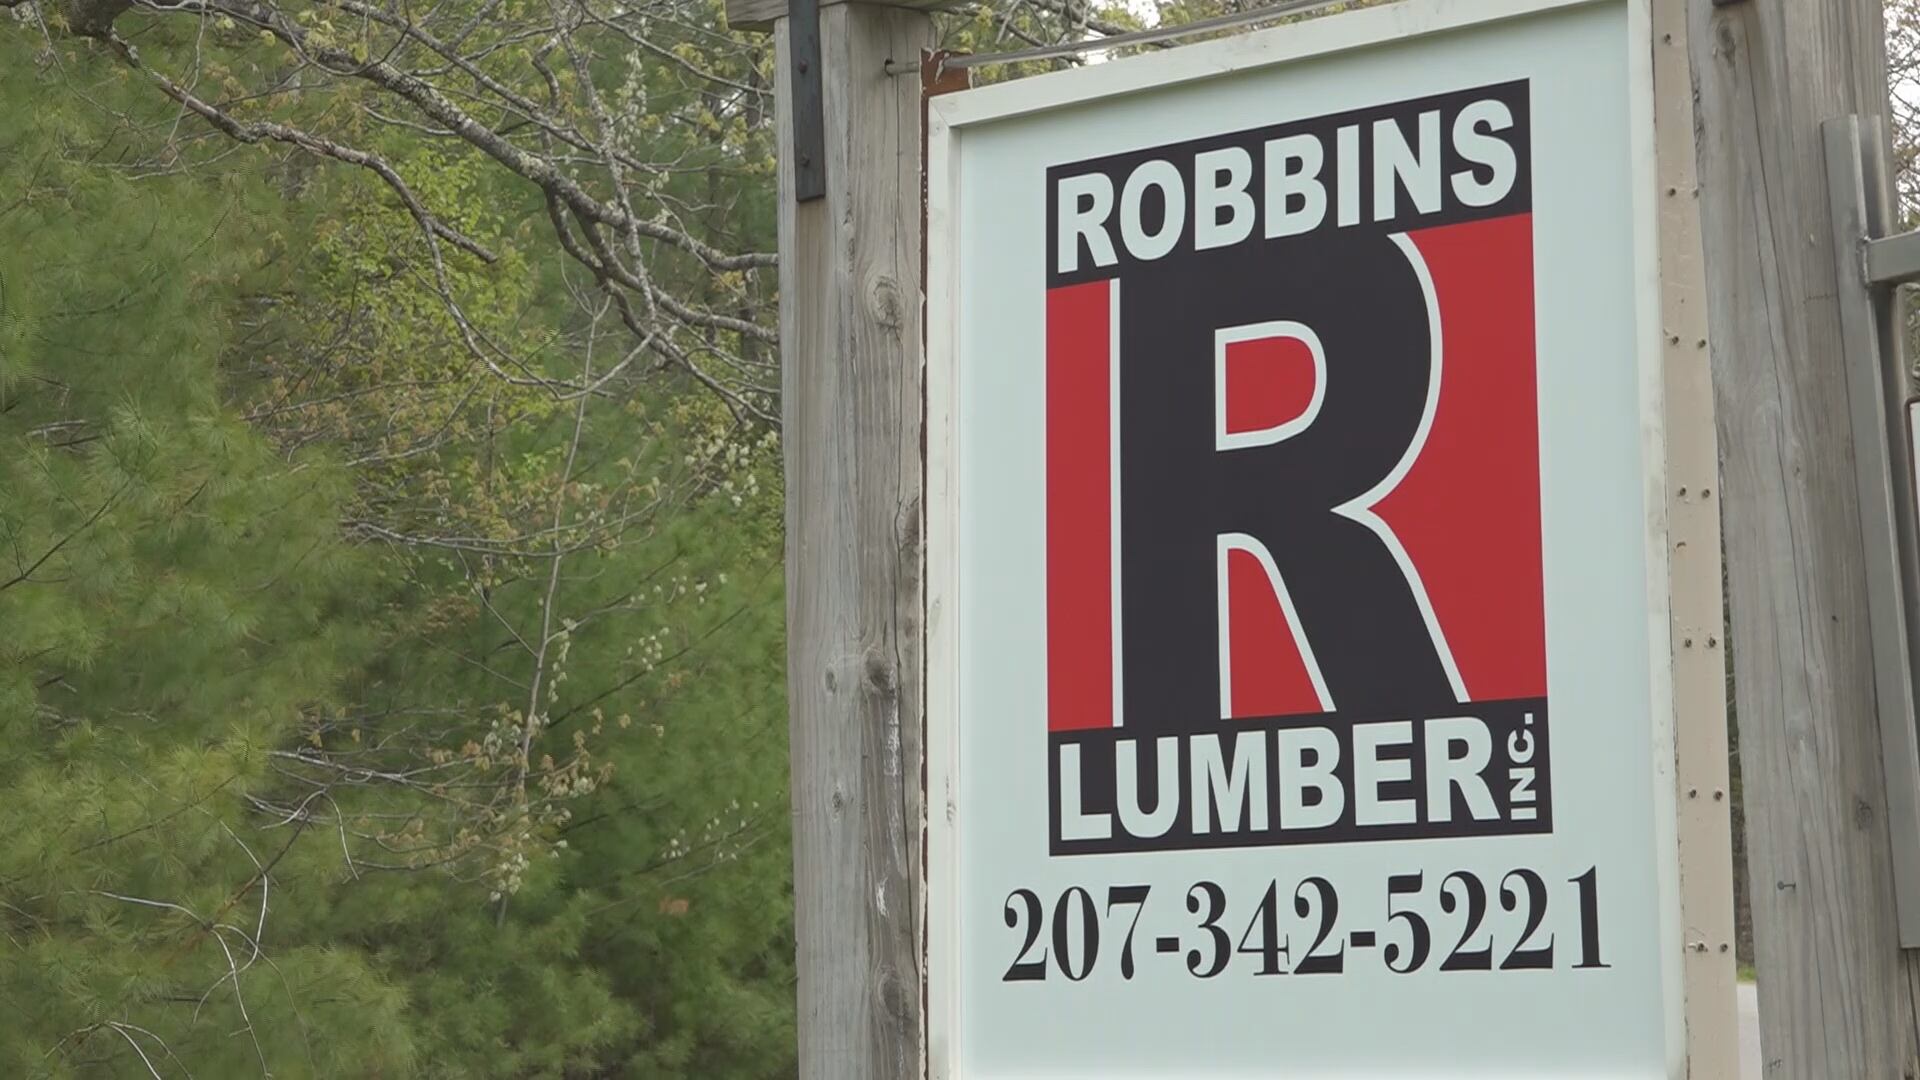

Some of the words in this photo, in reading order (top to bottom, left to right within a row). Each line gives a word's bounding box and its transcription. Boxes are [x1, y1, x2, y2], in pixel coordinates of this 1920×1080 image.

[1058, 100, 1516, 273] ROBBINS
[1110, 232, 1471, 728] R
[1060, 717, 1500, 840] LUMBER
[1508, 713, 1536, 820] INC.
[1003, 866, 1611, 981] 207-342-5221
